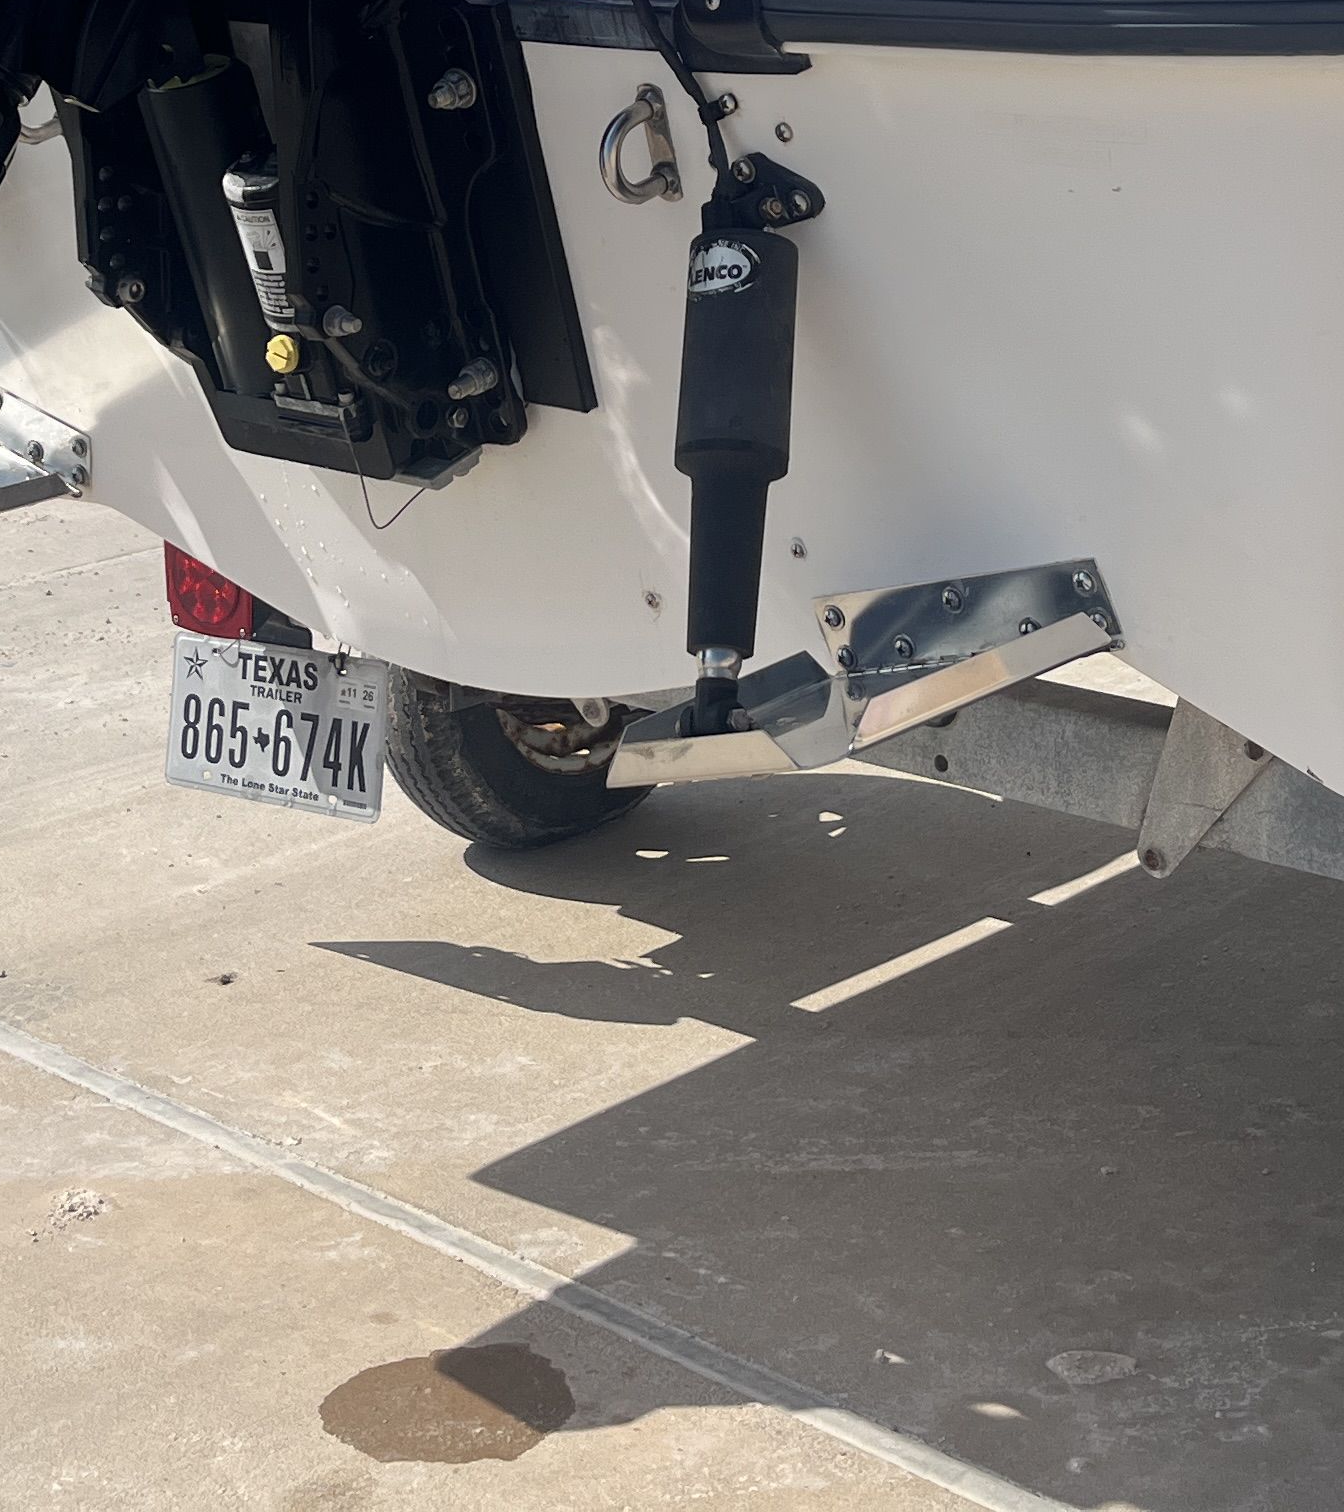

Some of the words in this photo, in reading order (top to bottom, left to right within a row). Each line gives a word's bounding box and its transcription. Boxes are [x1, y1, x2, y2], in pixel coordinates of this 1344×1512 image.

[238, 652, 319, 691] TEXAS
[250, 685, 302, 704] TRAILER
[220, 773, 239, 786] The
[241, 778, 265, 791] Lone
[268, 783, 289, 796] Star
[291, 787, 319, 801] State
